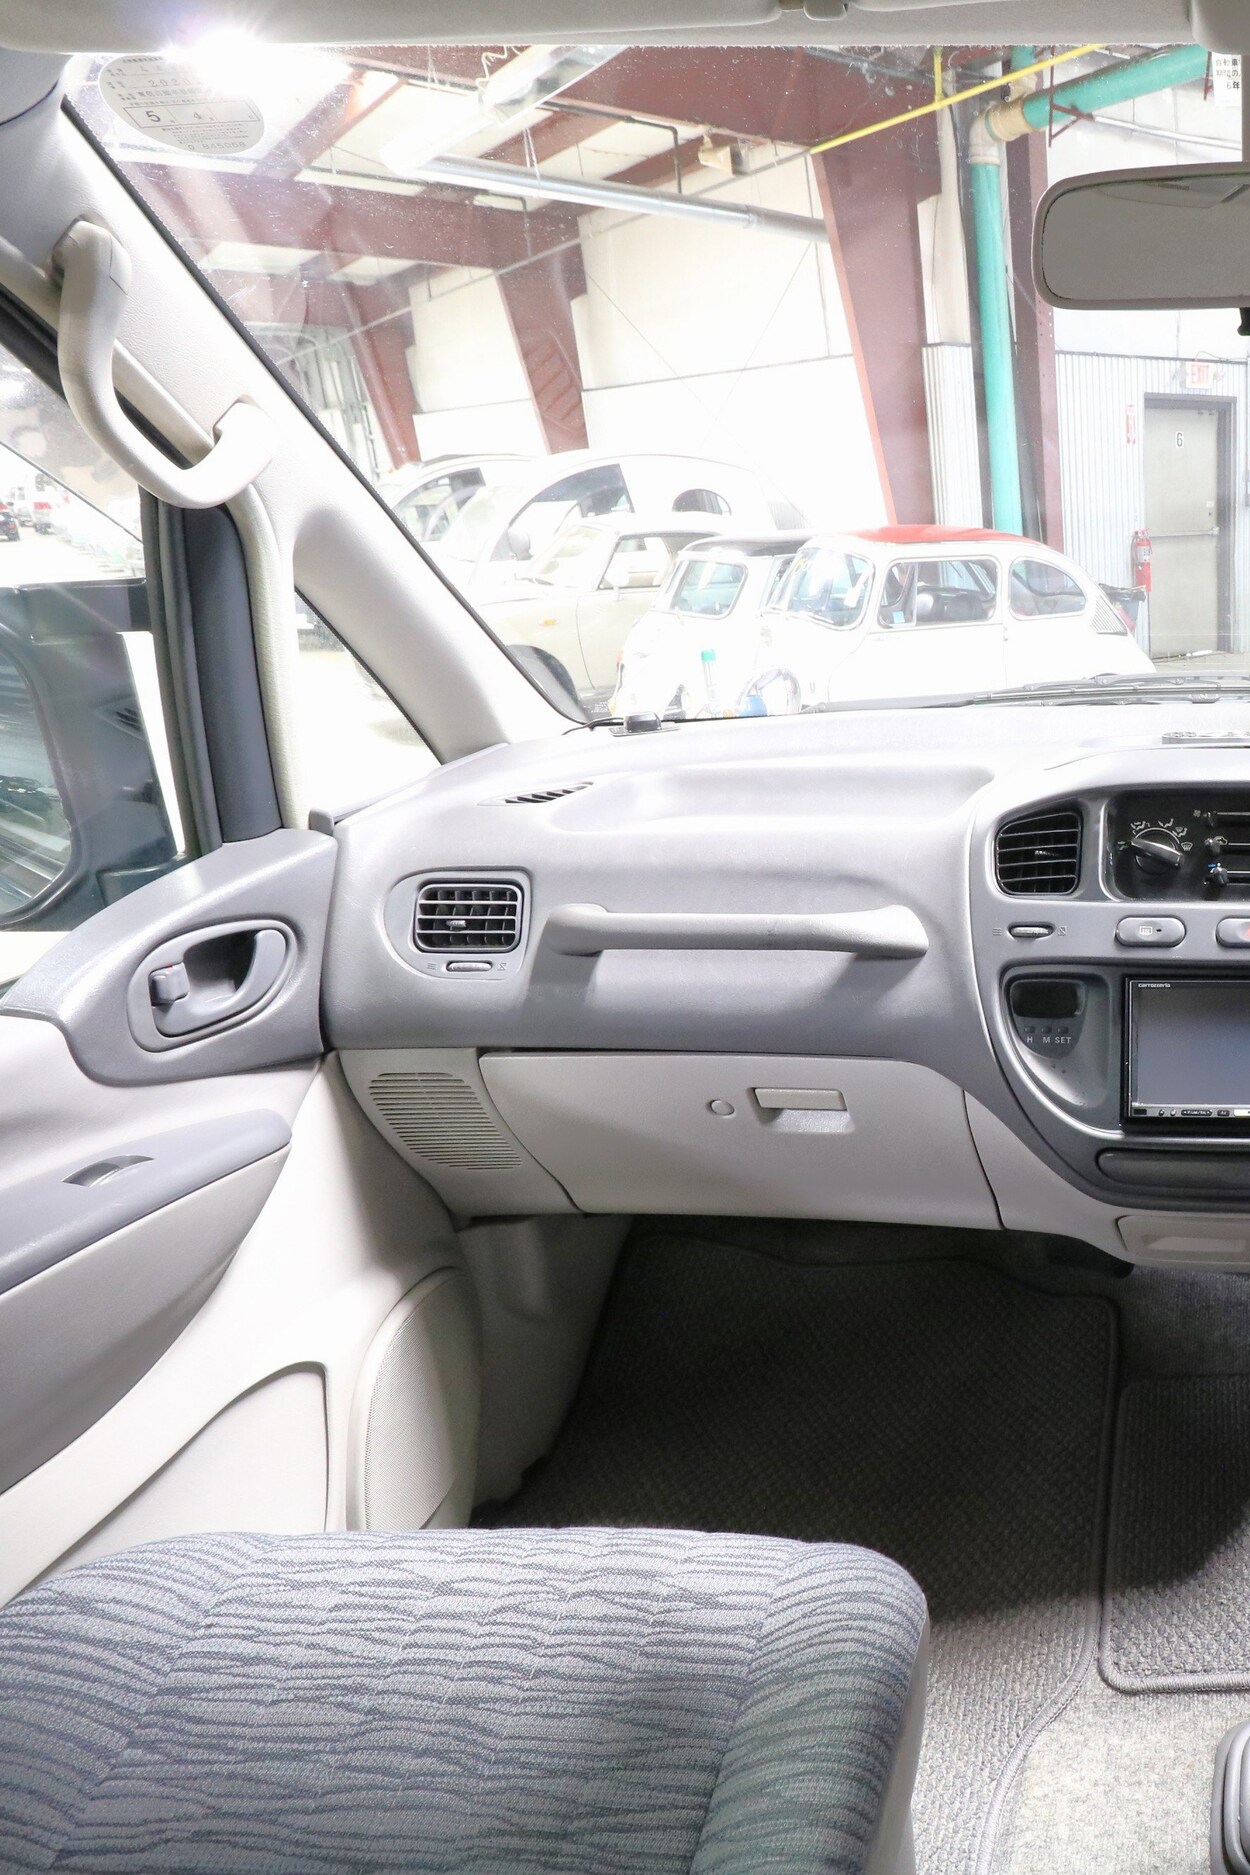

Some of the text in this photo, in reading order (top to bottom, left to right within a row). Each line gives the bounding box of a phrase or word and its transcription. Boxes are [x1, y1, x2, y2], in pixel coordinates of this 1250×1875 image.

[145, 110, 161, 123] 5
[1190, 364, 1211, 385] EXIT
[1176, 432, 1184, 448] 6
[1042, 1036, 1051, 1044] M
[1054, 1036, 1072, 1044] SET
